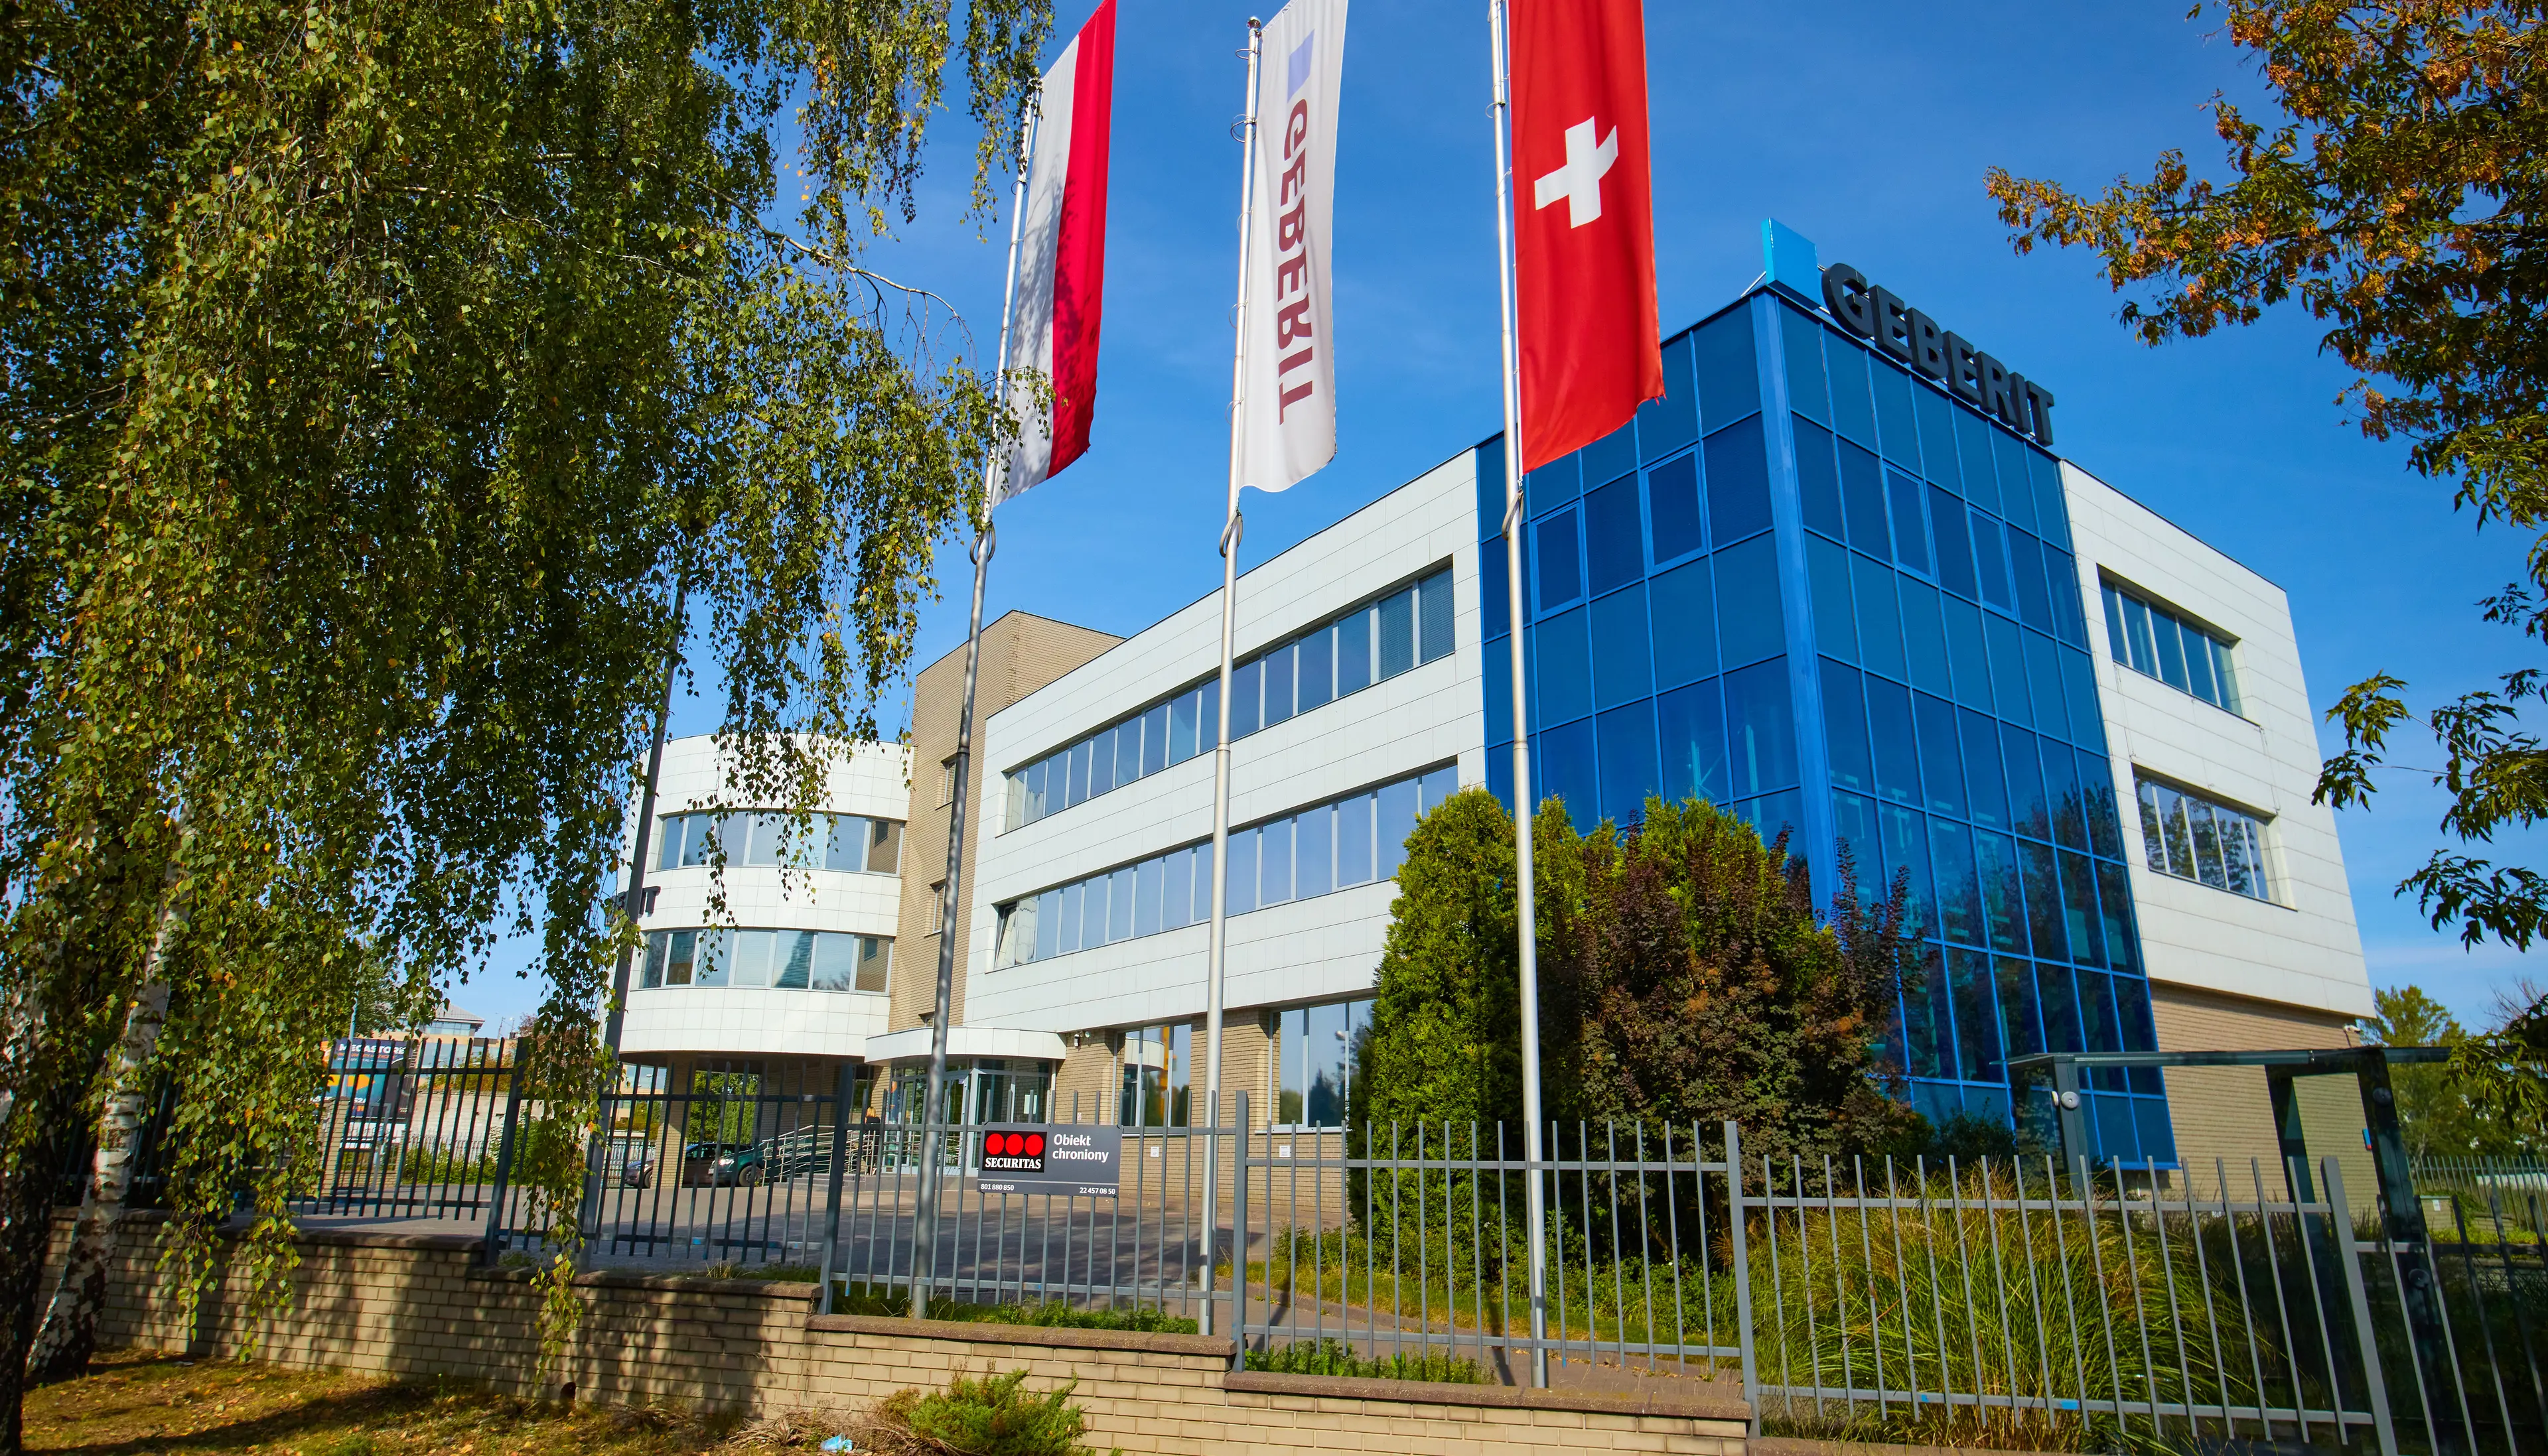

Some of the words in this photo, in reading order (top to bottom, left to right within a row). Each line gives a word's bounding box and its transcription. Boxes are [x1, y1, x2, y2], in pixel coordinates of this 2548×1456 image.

[1821, 263, 2054, 447] GEBERIT
[1054, 1134, 1092, 1146] Obiekt
[1052, 1148, 1109, 1163] chroniony
[985, 1157, 1042, 1169] SECURITAS
